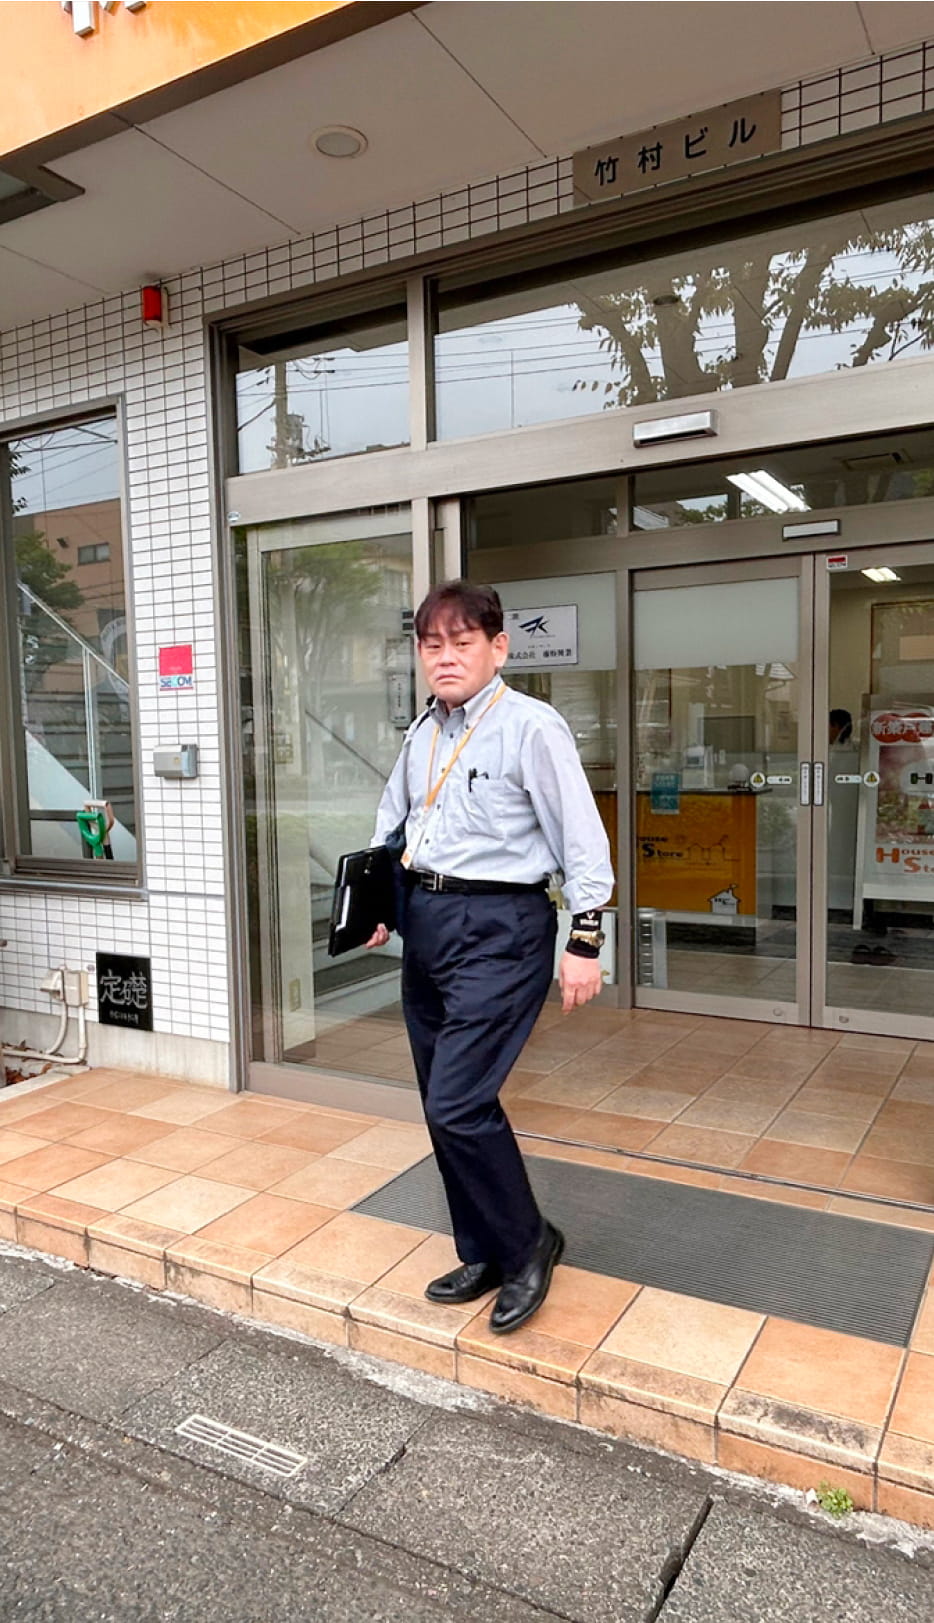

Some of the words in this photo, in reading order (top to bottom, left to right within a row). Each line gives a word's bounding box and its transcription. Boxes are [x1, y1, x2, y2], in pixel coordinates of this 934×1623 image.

[594, 117, 757, 186] 竹村ビル
[160, 675, 192, 688] SEOM
[642, 843, 683, 858] Store
[100, 968, 148, 1010] 定礎
